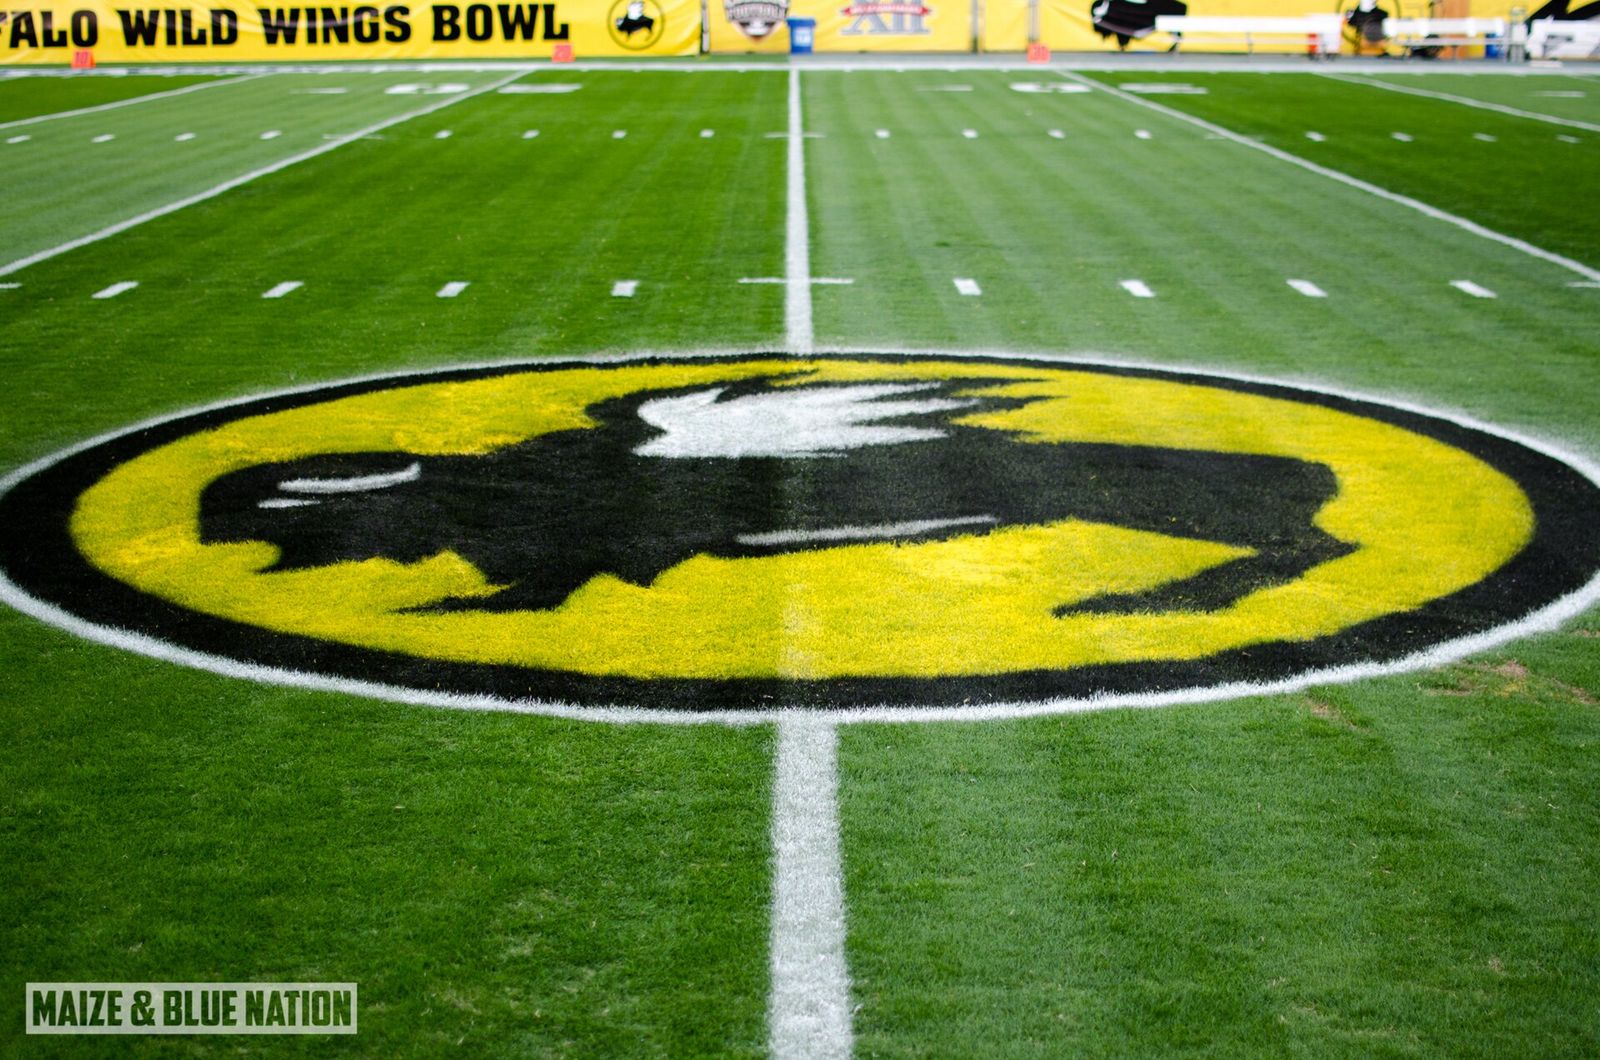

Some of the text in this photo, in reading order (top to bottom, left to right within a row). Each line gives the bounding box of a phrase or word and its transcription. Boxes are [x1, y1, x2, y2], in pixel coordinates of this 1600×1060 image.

[117, 9, 237, 45] WILD
[258, 6, 411, 43] WINGS
[432, 4, 569, 40] BOWL
